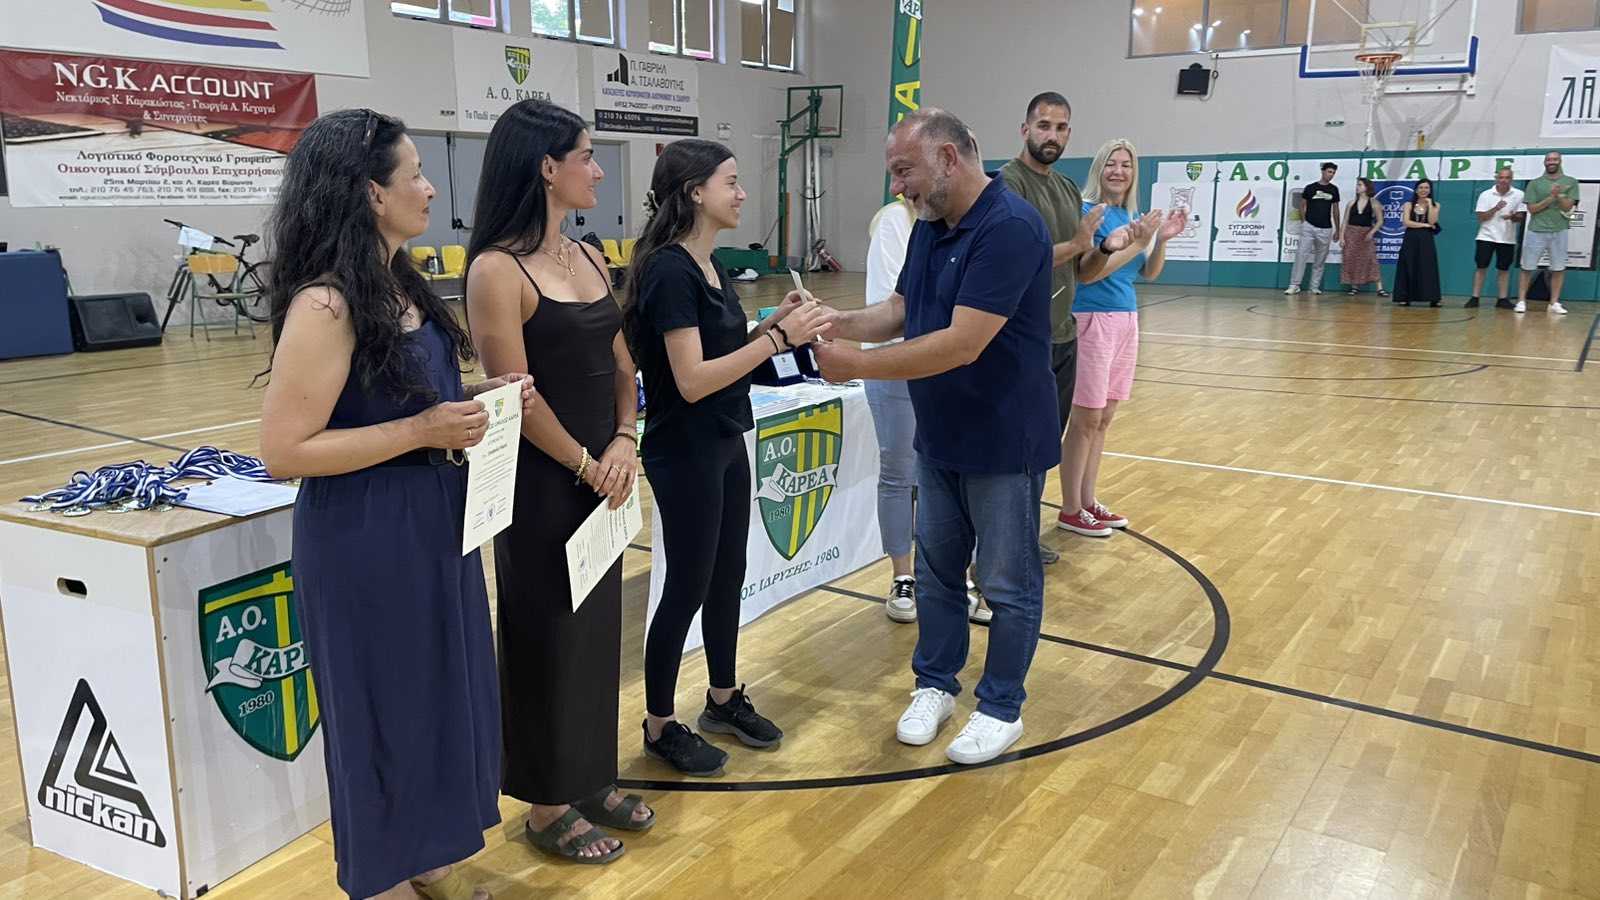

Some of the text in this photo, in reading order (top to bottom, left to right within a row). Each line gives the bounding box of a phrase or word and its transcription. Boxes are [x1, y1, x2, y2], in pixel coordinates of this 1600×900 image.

[56, 91, 110, 105] Νεκτάριος
[150, 72, 274, 99] ACCOUNT
[143, 110, 208, 123] & Συνεργάτες
[58, 163, 141, 175] Οικονομικοί
[144, 165, 208, 176] Σύμβουλοι
[77, 150, 271, 164] Λογιστικό Φοροτεχνικό Γραφείο
[1366, 157, 1564, 180] ΚΑΡΕ
[776, 467, 829, 494] ΚΑΡΕΑ
[769, 505, 791, 523] 1980
[740, 583, 756, 601] ΟΣ
[815, 546, 840, 566] 1980
[244, 643, 309, 676] ΚΑΡ
[238, 690, 275, 717] 1980
[44, 783, 158, 844] nickan
